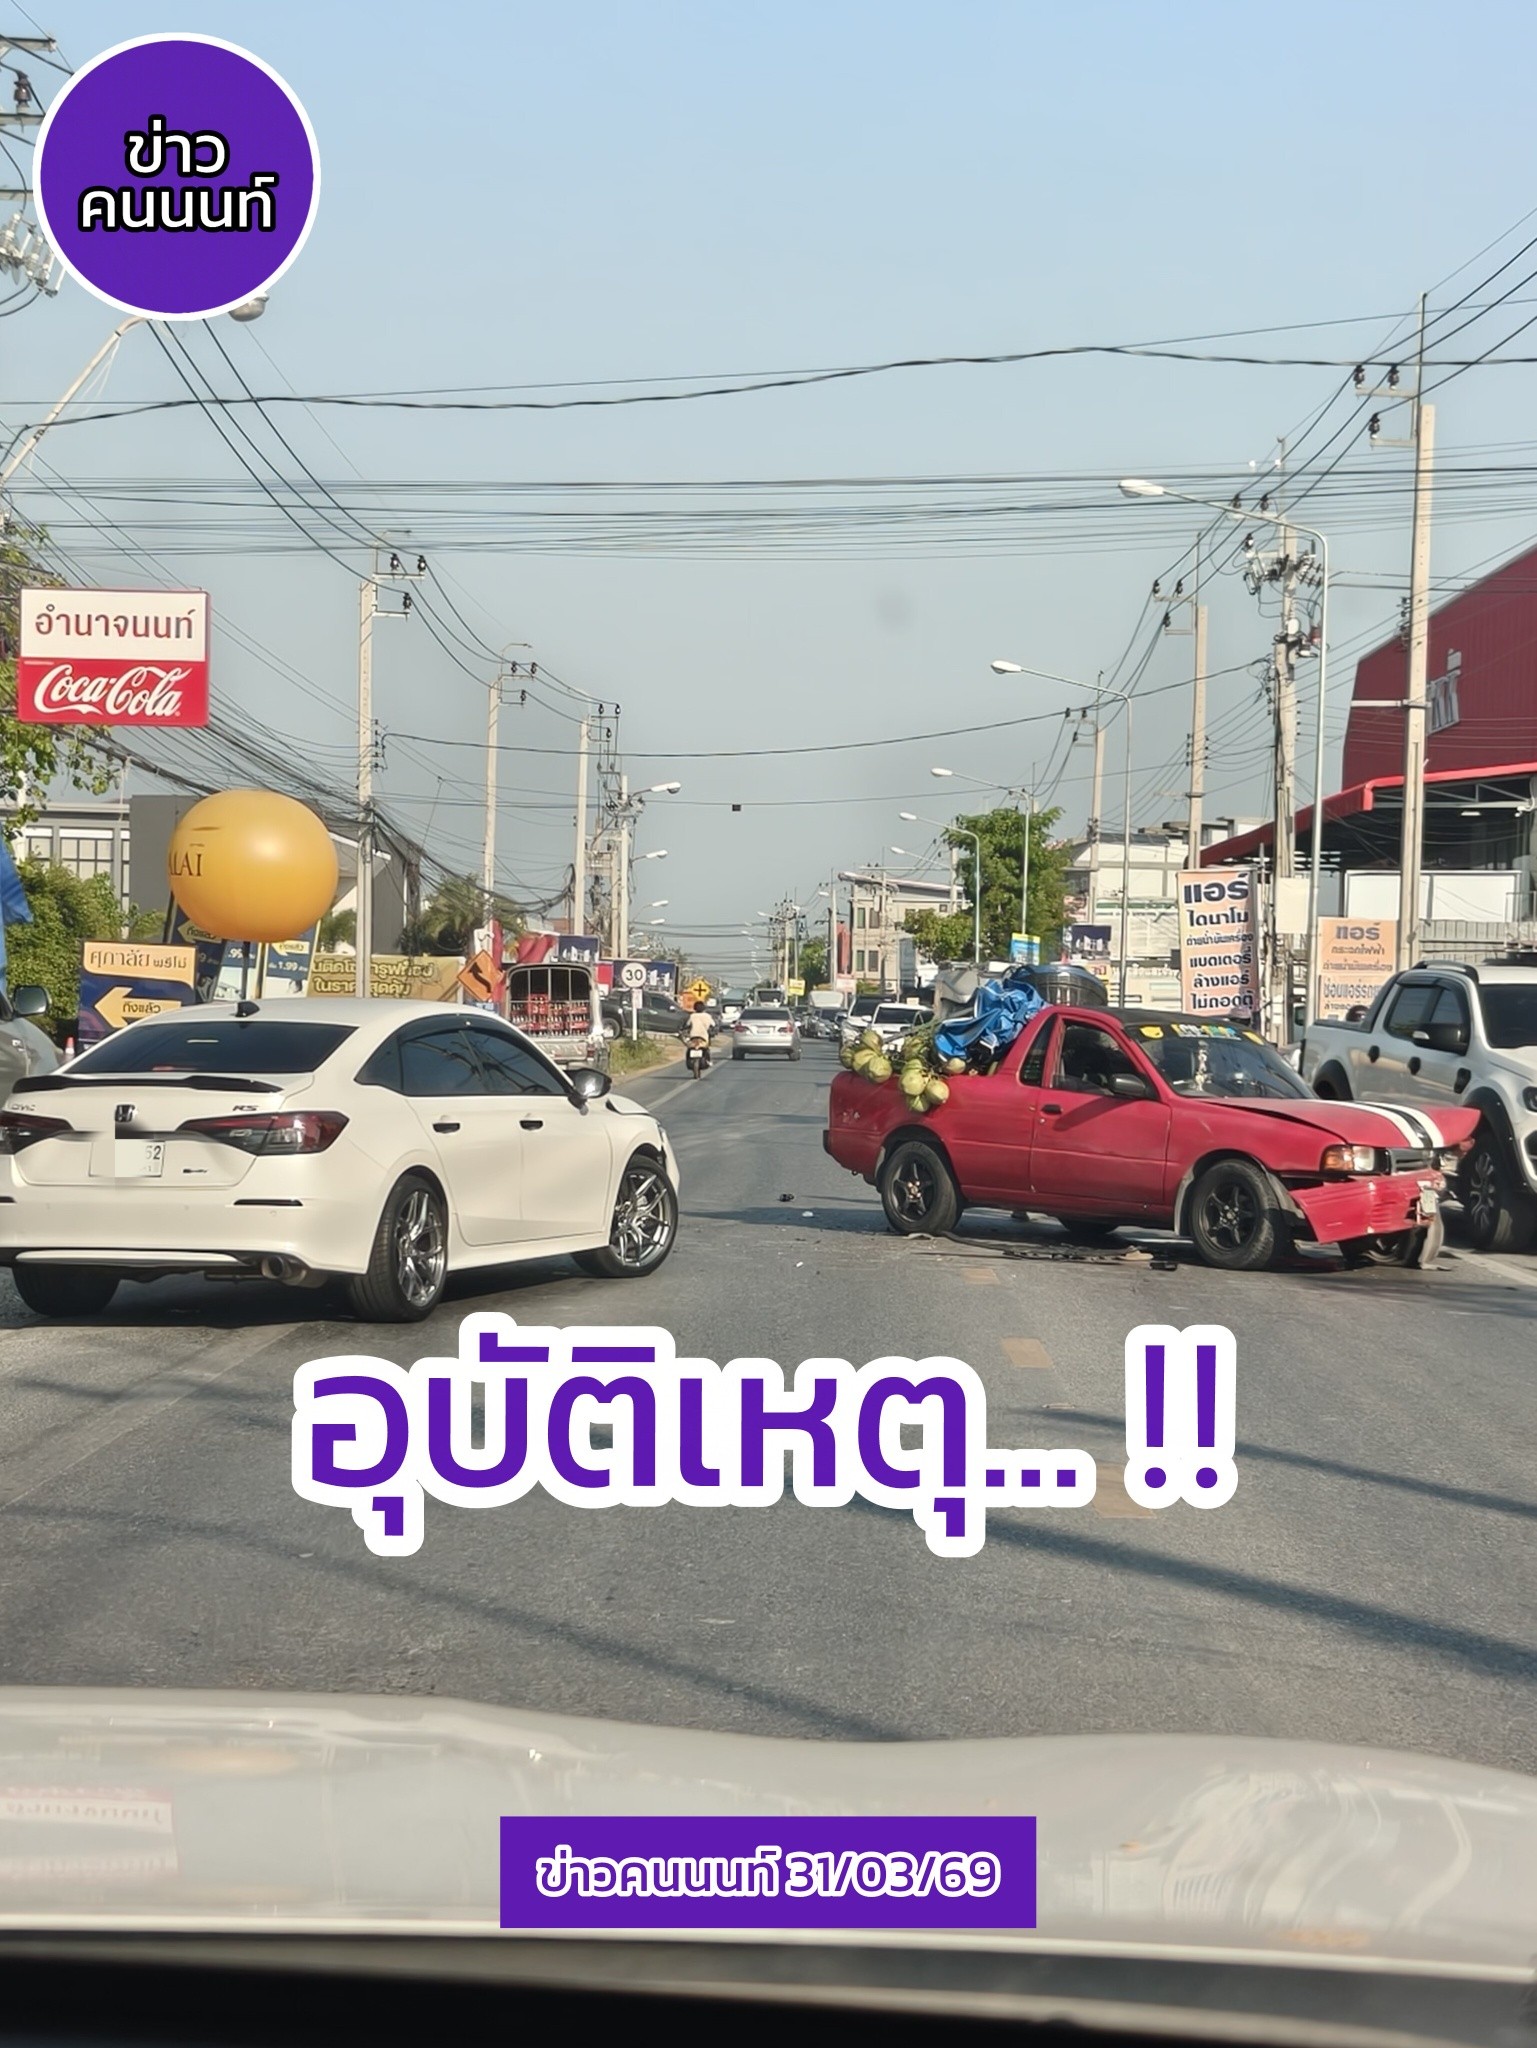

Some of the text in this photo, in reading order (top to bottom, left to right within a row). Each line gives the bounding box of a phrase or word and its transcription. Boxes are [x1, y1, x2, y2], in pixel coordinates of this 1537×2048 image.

[35, 603, 196, 639] อำนาจนนท์
[33, 663, 193, 717] Coca-Cola
[1183, 872, 1249, 904] แอร์
[1186, 906, 1249, 927] ไดนาโม
[1335, 922, 1381, 941] แอร์
[625, 968, 643, 981] 30
[1193, 969, 1250, 988] ล้างแอร์
[122, 1000, 161, 1014] ถึงแล้ว
